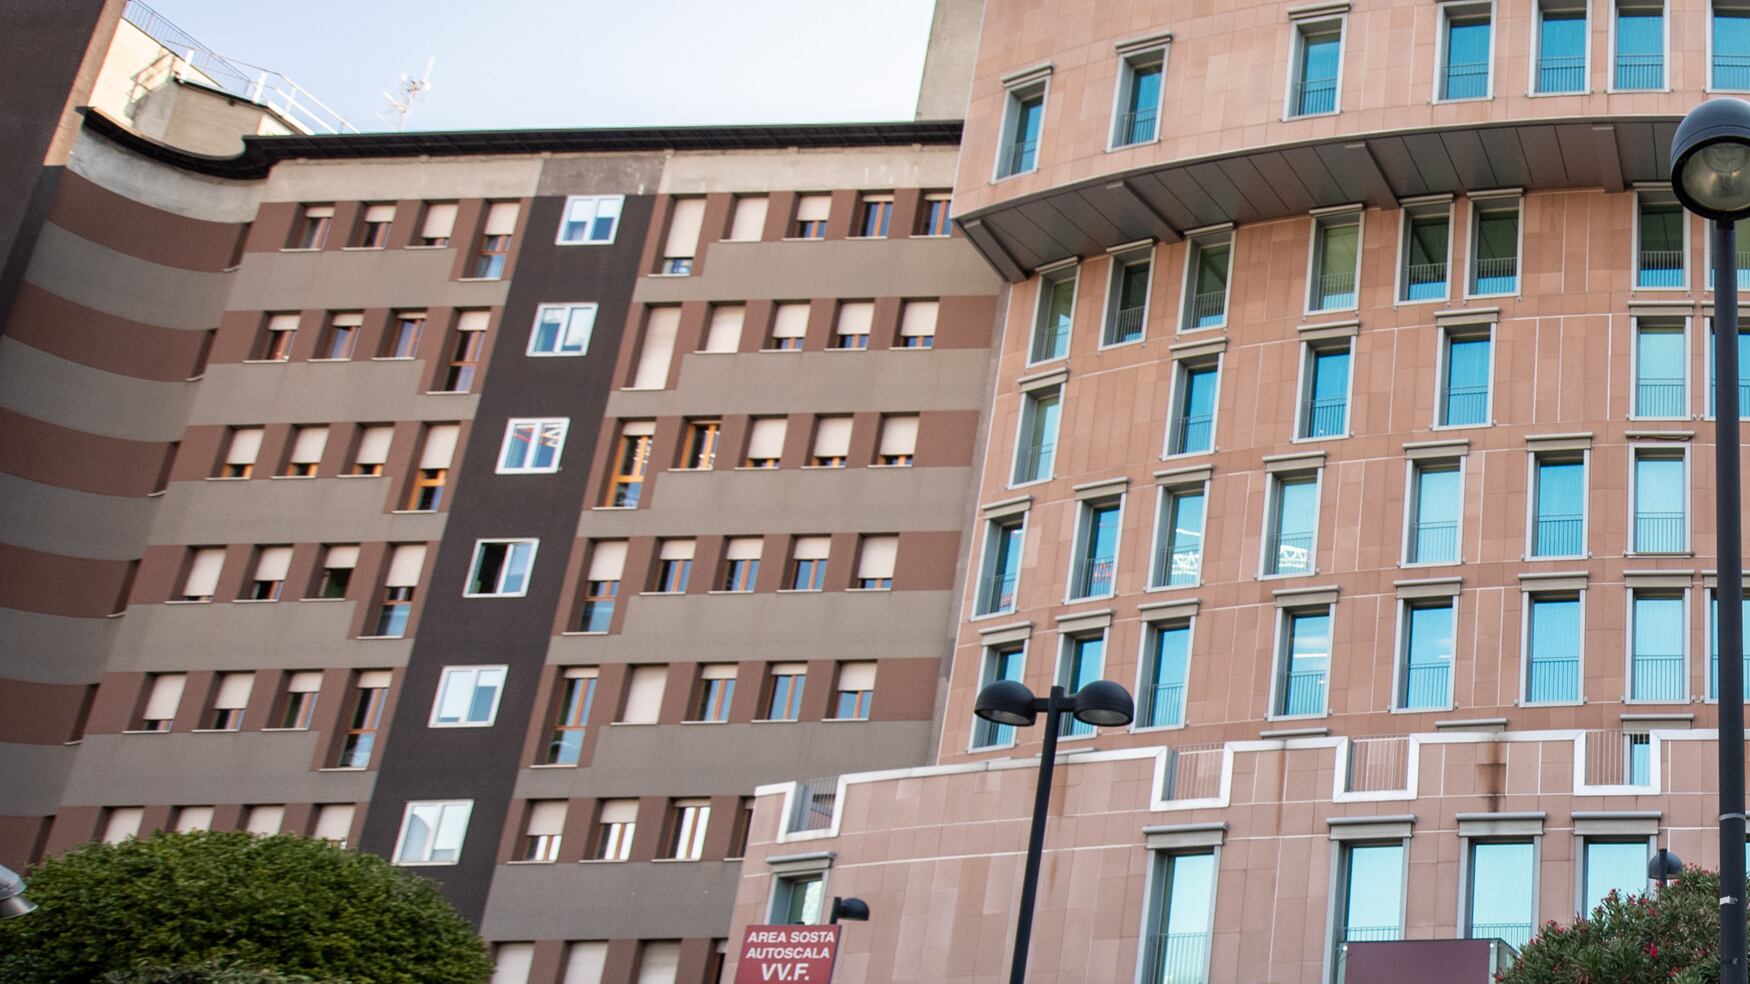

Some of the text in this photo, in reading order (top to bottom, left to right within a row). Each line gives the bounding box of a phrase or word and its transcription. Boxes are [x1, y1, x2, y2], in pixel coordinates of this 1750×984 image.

[747, 932, 835, 943] AREA SOSTA
[746, 948, 830, 959] AUTOSCALA
[761, 963, 809, 980] VV.F.
